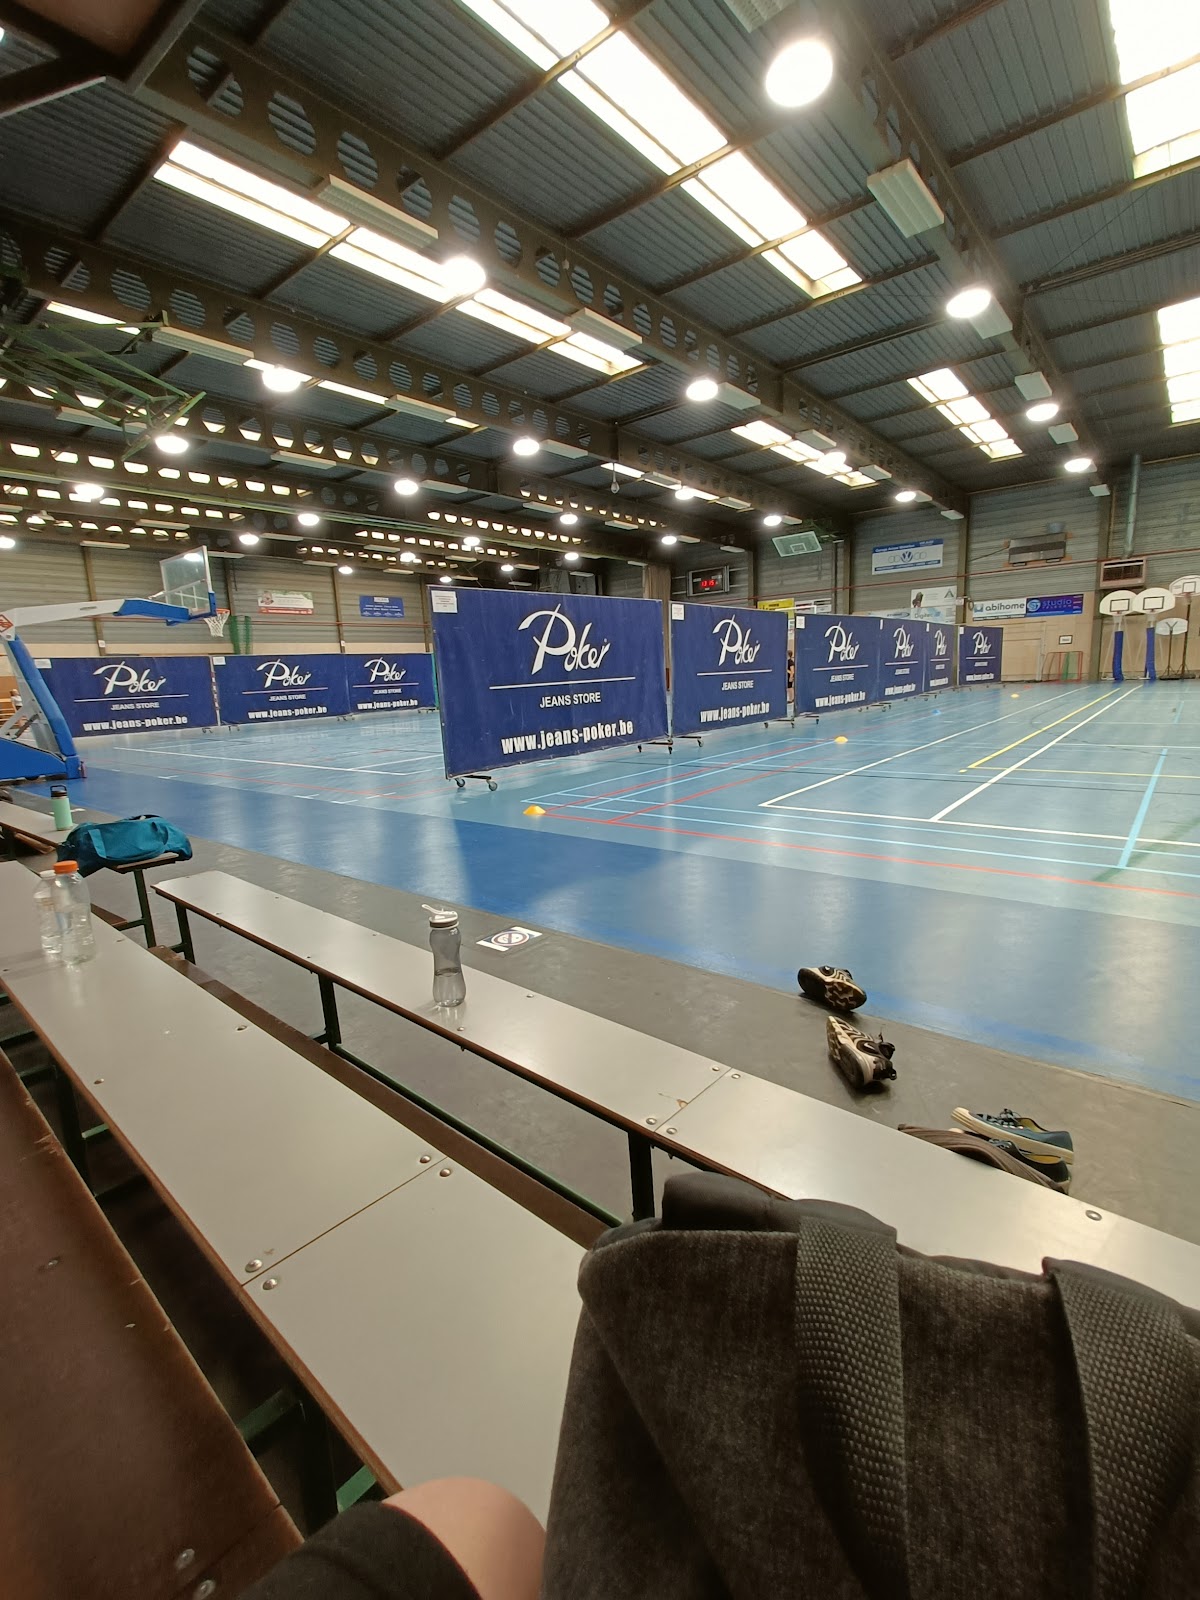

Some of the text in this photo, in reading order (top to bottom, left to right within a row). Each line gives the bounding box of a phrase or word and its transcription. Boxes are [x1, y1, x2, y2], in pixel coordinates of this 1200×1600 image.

[985, 602, 1025, 611] abihome
[1042, 599, 1072, 607] studio
[518, 603, 611, 675] Poker
[712, 614, 760, 666] Poker
[824, 621, 860, 663] Poker
[893, 625, 914, 658] Poker
[972, 630, 992, 655] Poker
[93, 661, 167, 695] Poker
[256, 659, 312, 688] Poker
[364, 657, 406, 683] Poker
[722, 680, 754, 691] JEANS STORE
[111, 703, 135, 711] JEANS
[248, 705, 328, 719] www.jeans-poker.be
[540, 692, 601, 708] JEANS STORE
[700, 701, 770, 723] www.jeans-poker.be
[83, 715, 188, 731] www.jeans-poker.be
[501, 719, 634, 755] www.jeans-poker.be
